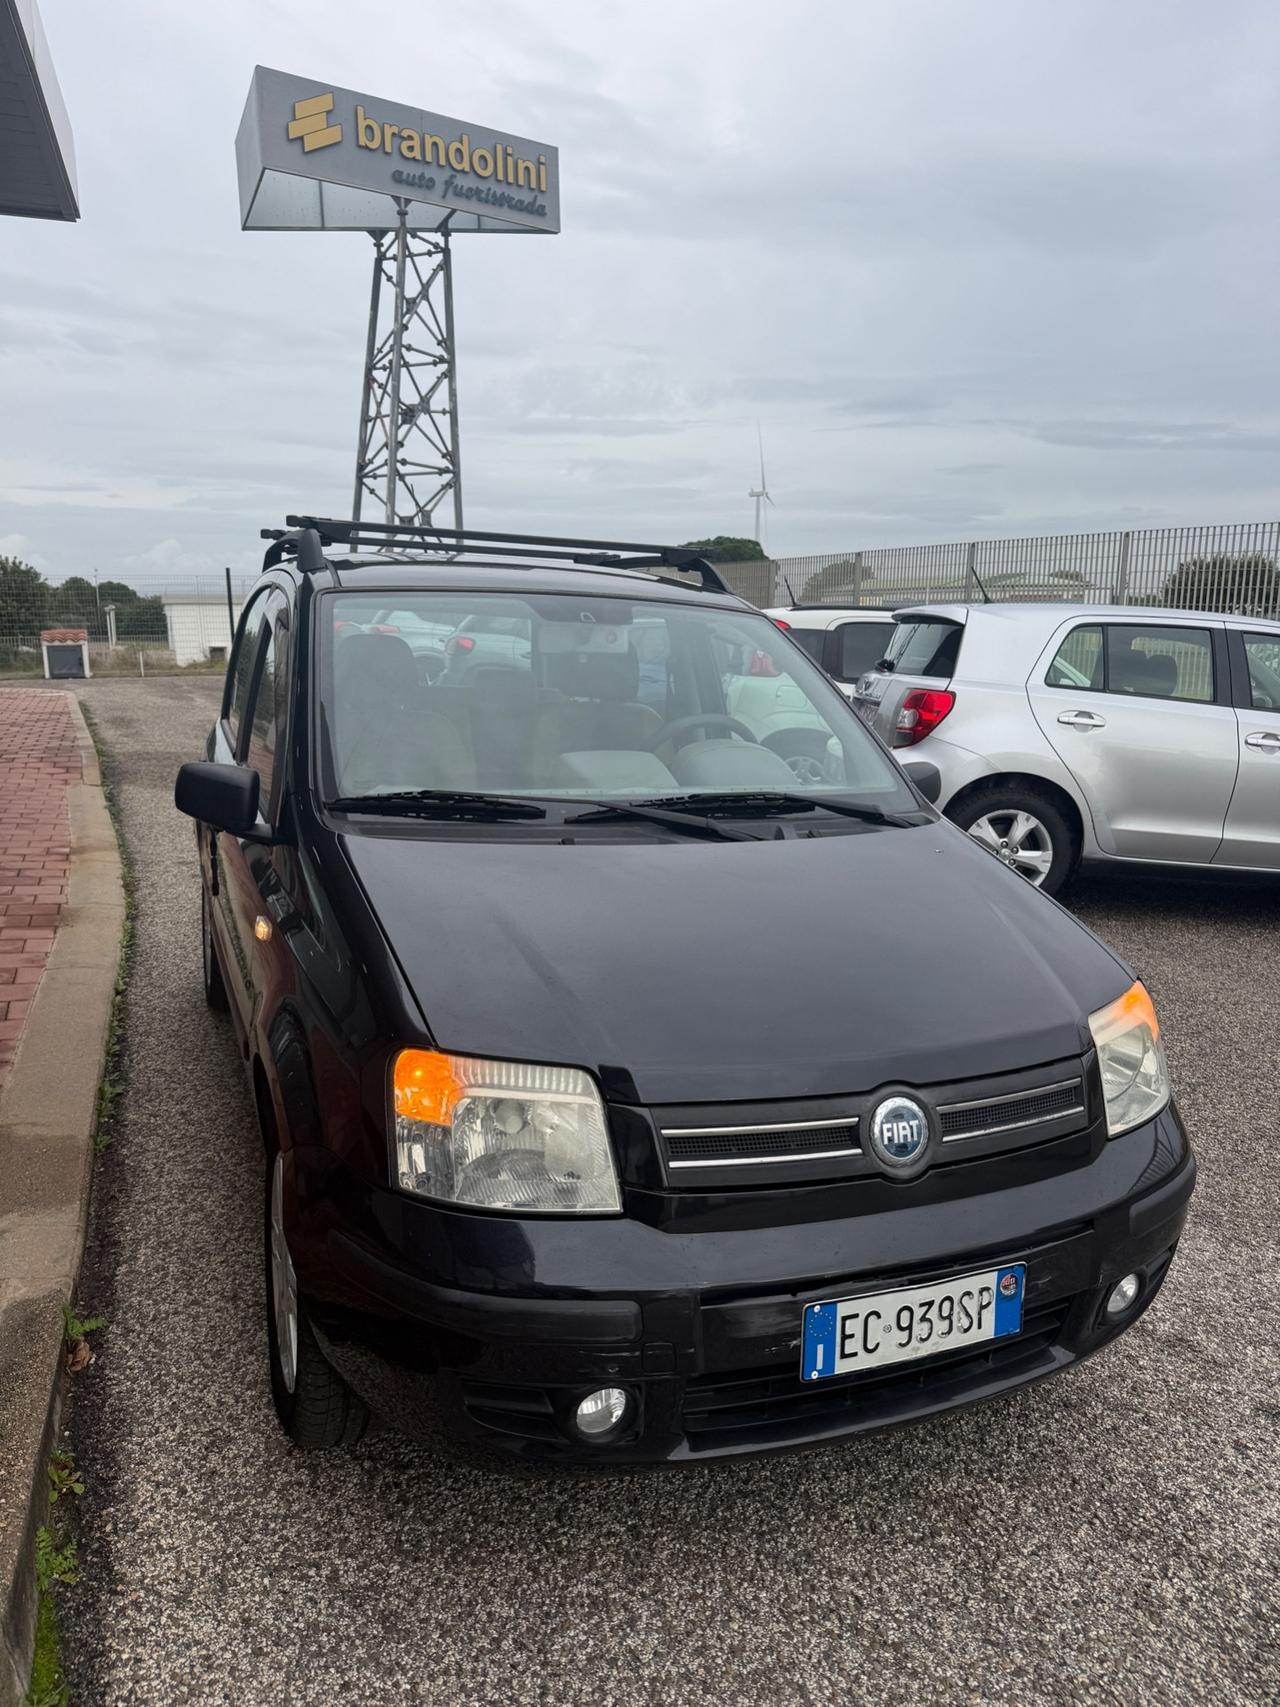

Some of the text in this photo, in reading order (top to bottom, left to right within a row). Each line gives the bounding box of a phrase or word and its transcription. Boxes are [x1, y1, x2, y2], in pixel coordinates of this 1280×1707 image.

[356, 105, 548, 192] brandolini
[391, 169, 547, 216] auto fuoristrada
[882, 1120, 919, 1145] FIAT
[839, 1286, 994, 1360] EC 939SP
